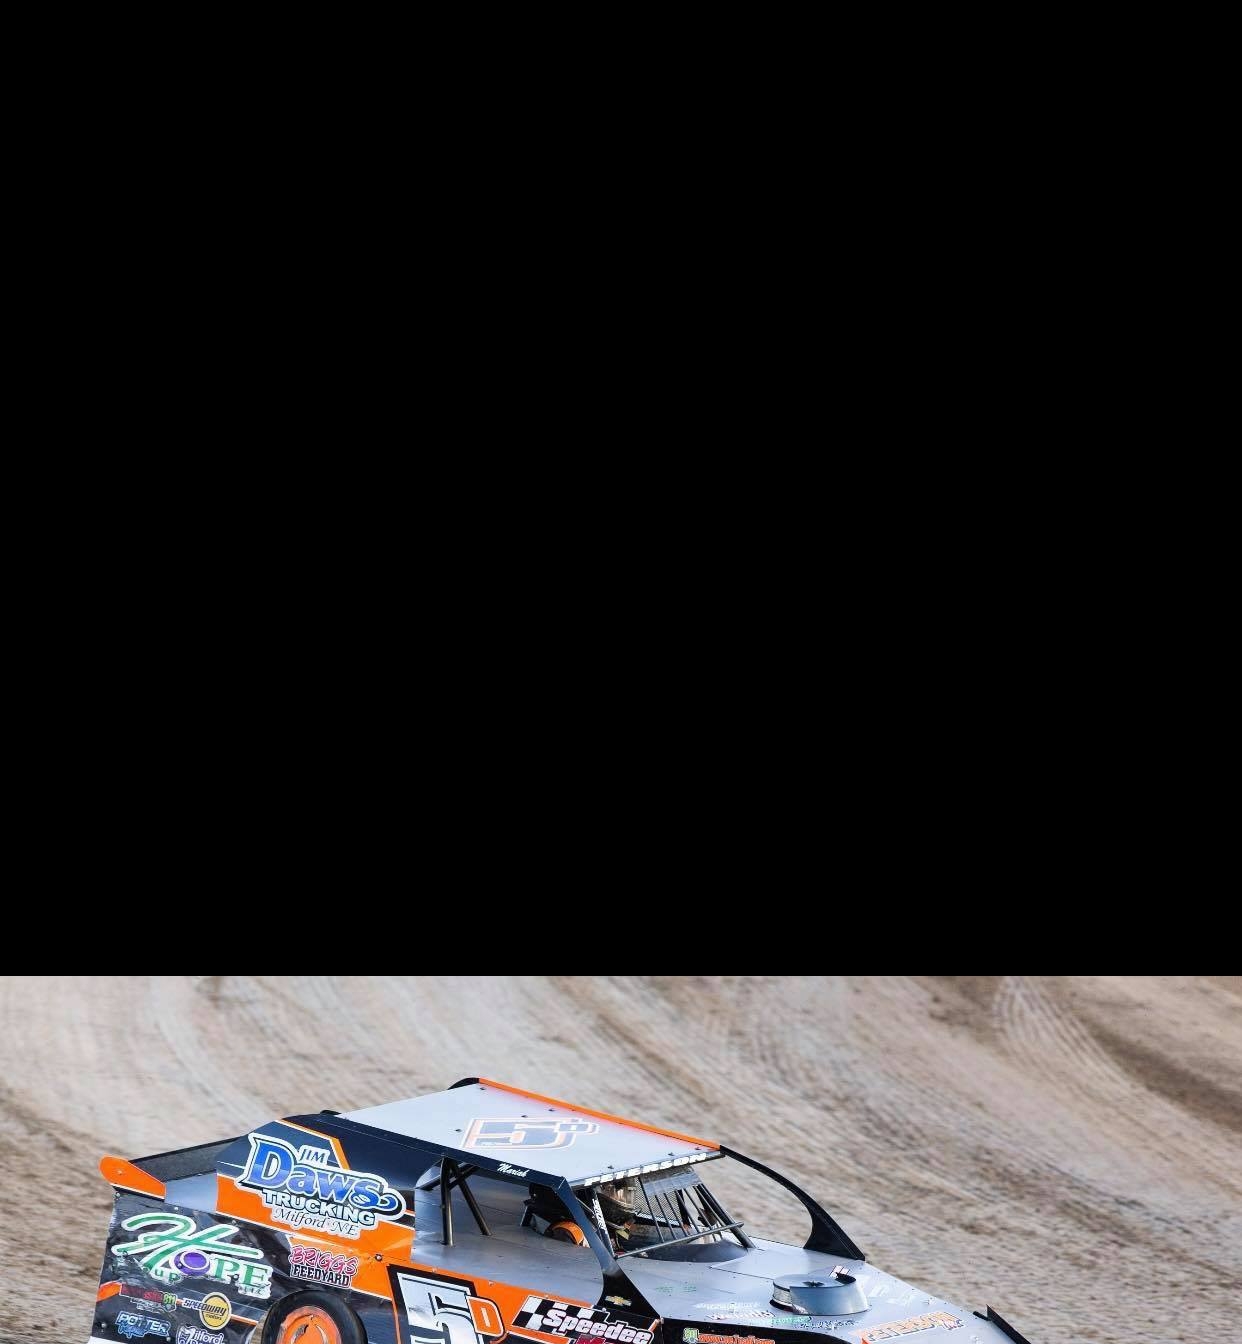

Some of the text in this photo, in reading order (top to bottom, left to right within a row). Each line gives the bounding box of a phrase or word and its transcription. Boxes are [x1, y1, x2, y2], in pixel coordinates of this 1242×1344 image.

[301, 1147, 327, 1162] JIM
[241, 1138, 401, 1214] Daws
[262, 1189, 375, 1226] TRUCKING
[274, 1208, 326, 1229] Milford
[290, 1246, 358, 1275] BRIGGS
[293, 1265, 351, 1287] FEEDYARD
[183, 1298, 227, 1317] SPEEDWAY
[119, 1314, 168, 1333] POTTER
